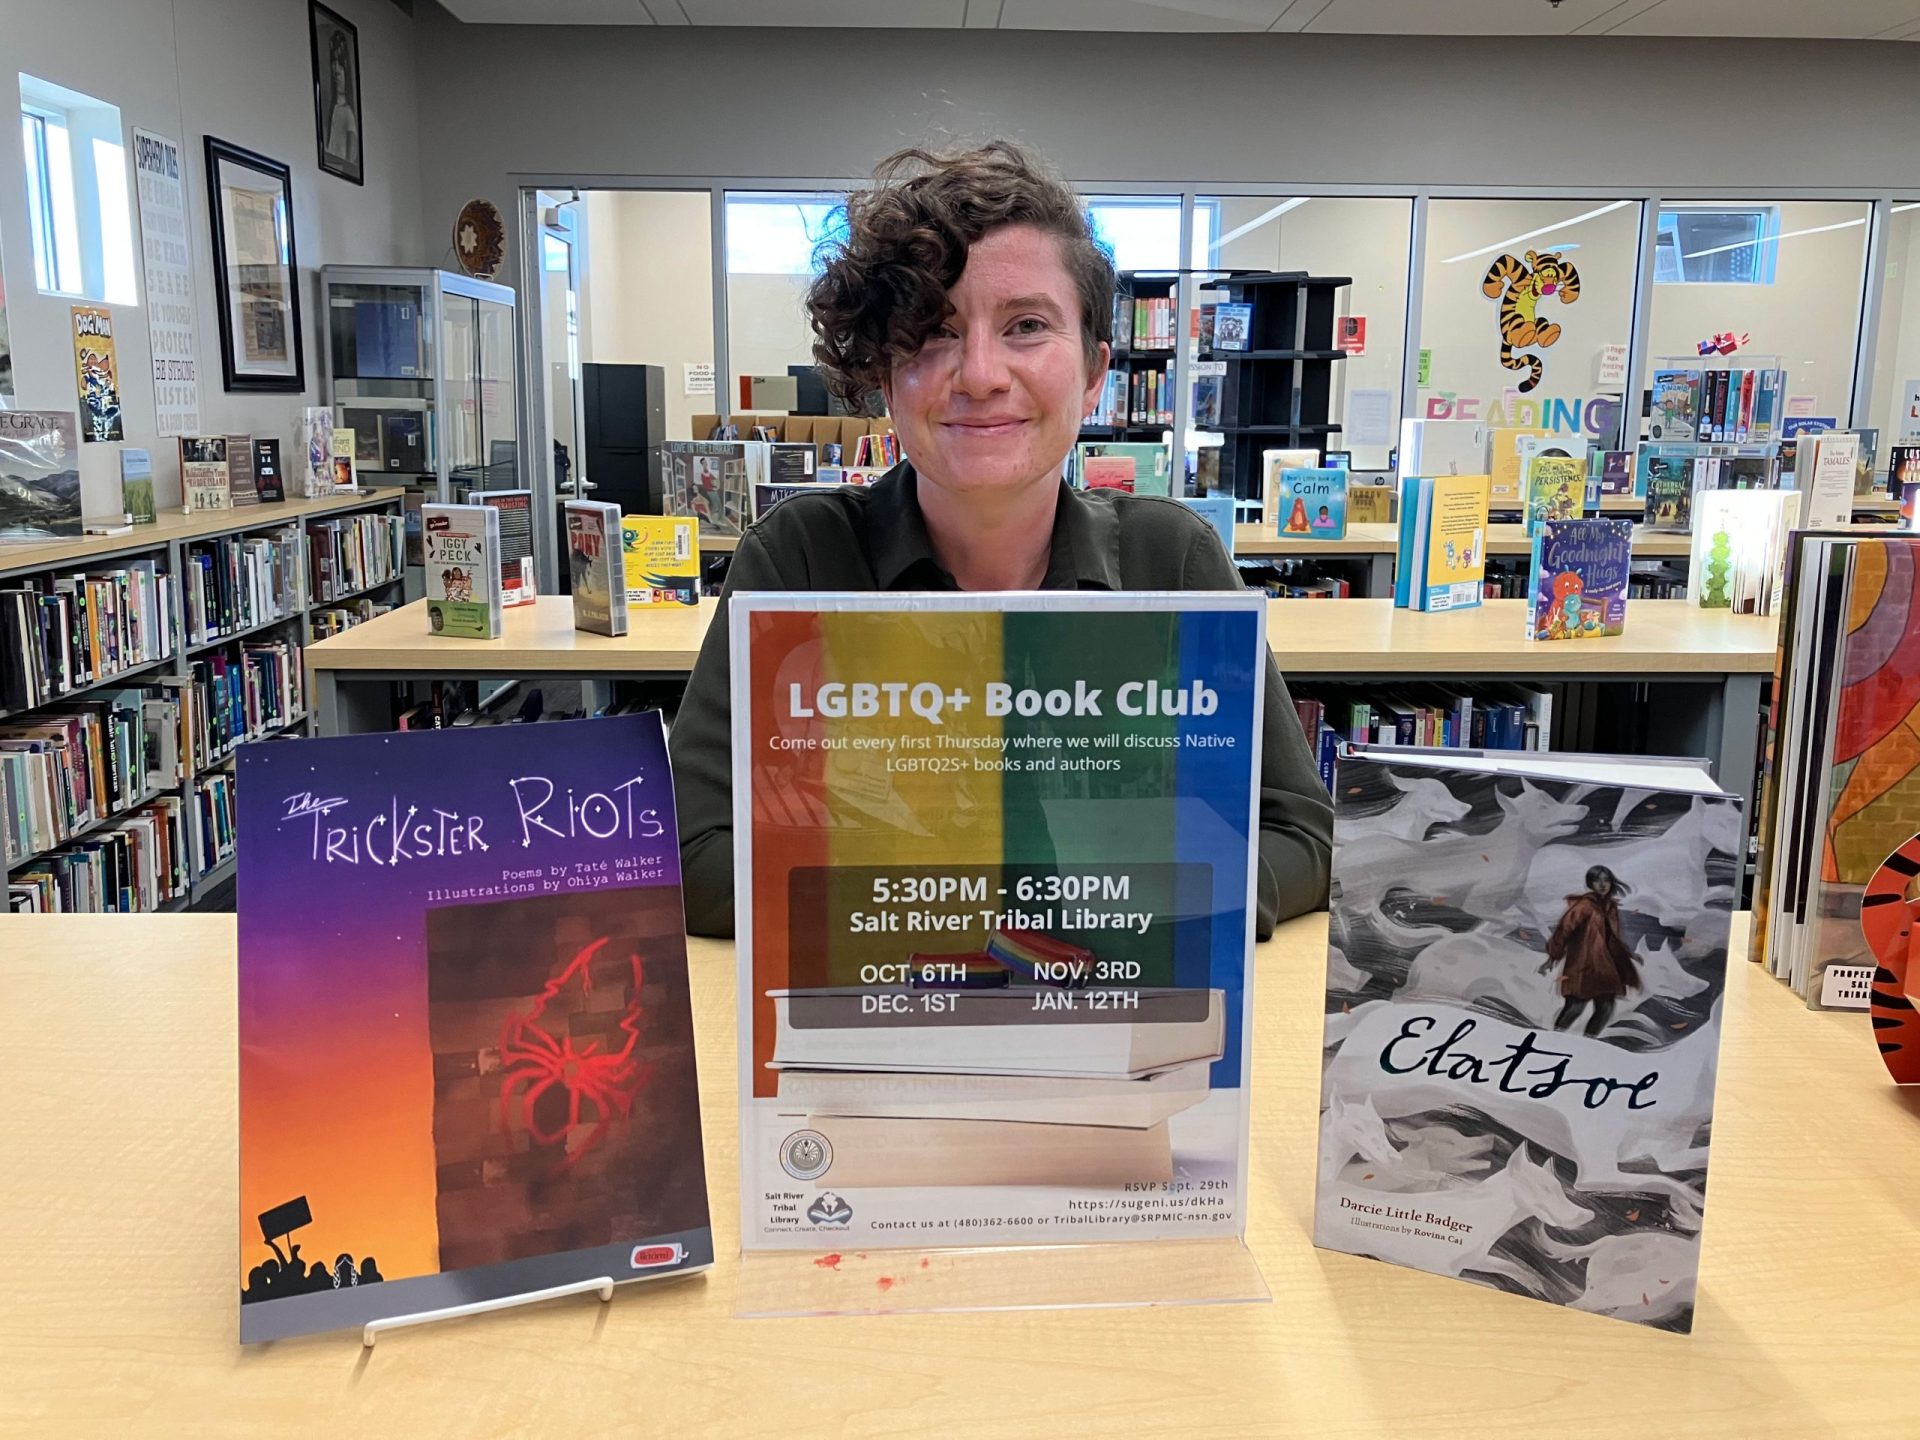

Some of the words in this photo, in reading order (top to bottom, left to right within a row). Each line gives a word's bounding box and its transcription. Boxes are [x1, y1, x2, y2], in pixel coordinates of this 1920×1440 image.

[75, 313, 95, 338] DOG
[95, 313, 112, 339] MAN
[152, 329, 193, 355] PROTECT
[155, 359, 166, 380] BE
[168, 360, 195, 381] STRONG
[157, 386, 197, 406] LISTEN
[671, 442, 686, 453] LOVE
[709, 443, 735, 455] LIBRARY
[1293, 482, 1330, 495] Calm
[1534, 474, 1582, 486] PERSISTENCE
[443, 538, 468, 549] IGGY
[571, 530, 600, 557] PONY
[1570, 527, 1587, 545] All
[1590, 526, 1605, 544] My
[439, 550, 472, 562] PECK
[1547, 541, 1626, 569] Goodnight
[1586, 563, 1619, 587] Hugs
[790, 682, 971, 725] LGBTQ+
[986, 681, 1103, 717] Book
[1117, 680, 1219, 717] Club
[769, 735, 817, 750] Come
[820, 736, 848, 750] out
[852, 737, 895, 752] every
[900, 734, 931, 749] first
[935, 734, 1009, 752] Thursday
[1012, 733, 1062, 749] where
[1066, 737, 1089, 748] we
[1093, 733, 1119, 748] will
[1123, 733, 1181, 748] discuss
[1185, 733, 1236, 748] Native
[886, 757, 970, 775] LGBTQ2S+
[974, 756, 1022, 771] books
[1026, 756, 1056, 771] and
[1060, 756, 1121, 771] authors
[281, 792, 349, 820] The
[311, 795, 490, 866] TRICKSTER
[508, 776, 665, 848] RIOTS
[502, 868, 543, 881] Poems
[551, 864, 567, 877] by
[575, 859, 608, 872] Taté
[615, 854, 663, 868] Walker
[427, 880, 534, 901] Illustrations
[543, 878, 559, 893] by
[616, 867, 664, 881] Walker
[873, 876, 988, 903] 5:30PM
[1015, 875, 1130, 901] 6:30PM
[850, 911, 899, 932] Salt
[907, 910, 974, 931] River
[979, 909, 1053, 931] Tribal
[1062, 909, 1152, 933] Library
[860, 963, 915, 984] OCT.
[921, 962, 967, 982] 6TH
[1033, 961, 1089, 981] NOV.
[1095, 960, 1141, 980] 3RD
[1833, 970, 1874, 978] PROPER
[861, 995, 914, 1013] DEC.
[920, 994, 960, 1012] 1ST
[1032, 992, 1079, 1011] JAN.
[1085, 991, 1139, 1010] 12TH
[1379, 1016, 1659, 1109] Elatsoe
[765, 1191, 782, 1200] Salt
[783, 1191, 804, 1200] River
[1124, 1182, 1157, 1192] RSVP
[1162, 1181, 1195, 1193] Sept.
[1200, 1179, 1228, 1190] 29th
[773, 1203, 796, 1211] Tribal
[1340, 1197, 1382, 1216] Darcie
[1385, 1203, 1422, 1222] Little
[1425, 1209, 1473, 1234] Badger
[770, 1215, 799, 1225] Library
[871, 1220, 916, 1230] Contact
[921, 1221, 934, 1229] us
[938, 1220, 950, 1228] at
[954, 1216, 1033, 1229] (480)362-6600
[1038, 1217, 1050, 1225] or
[1054, 1212, 1232, 1225] TribalLibrary@SRPMIC-nsn.gov
[1350, 1216, 1400, 1234] Illustrations
[1401, 1224, 1413, 1236] by
[1413, 1228, 1446, 1242] Rovina
[1448, 1234, 1463, 1245] Cai
